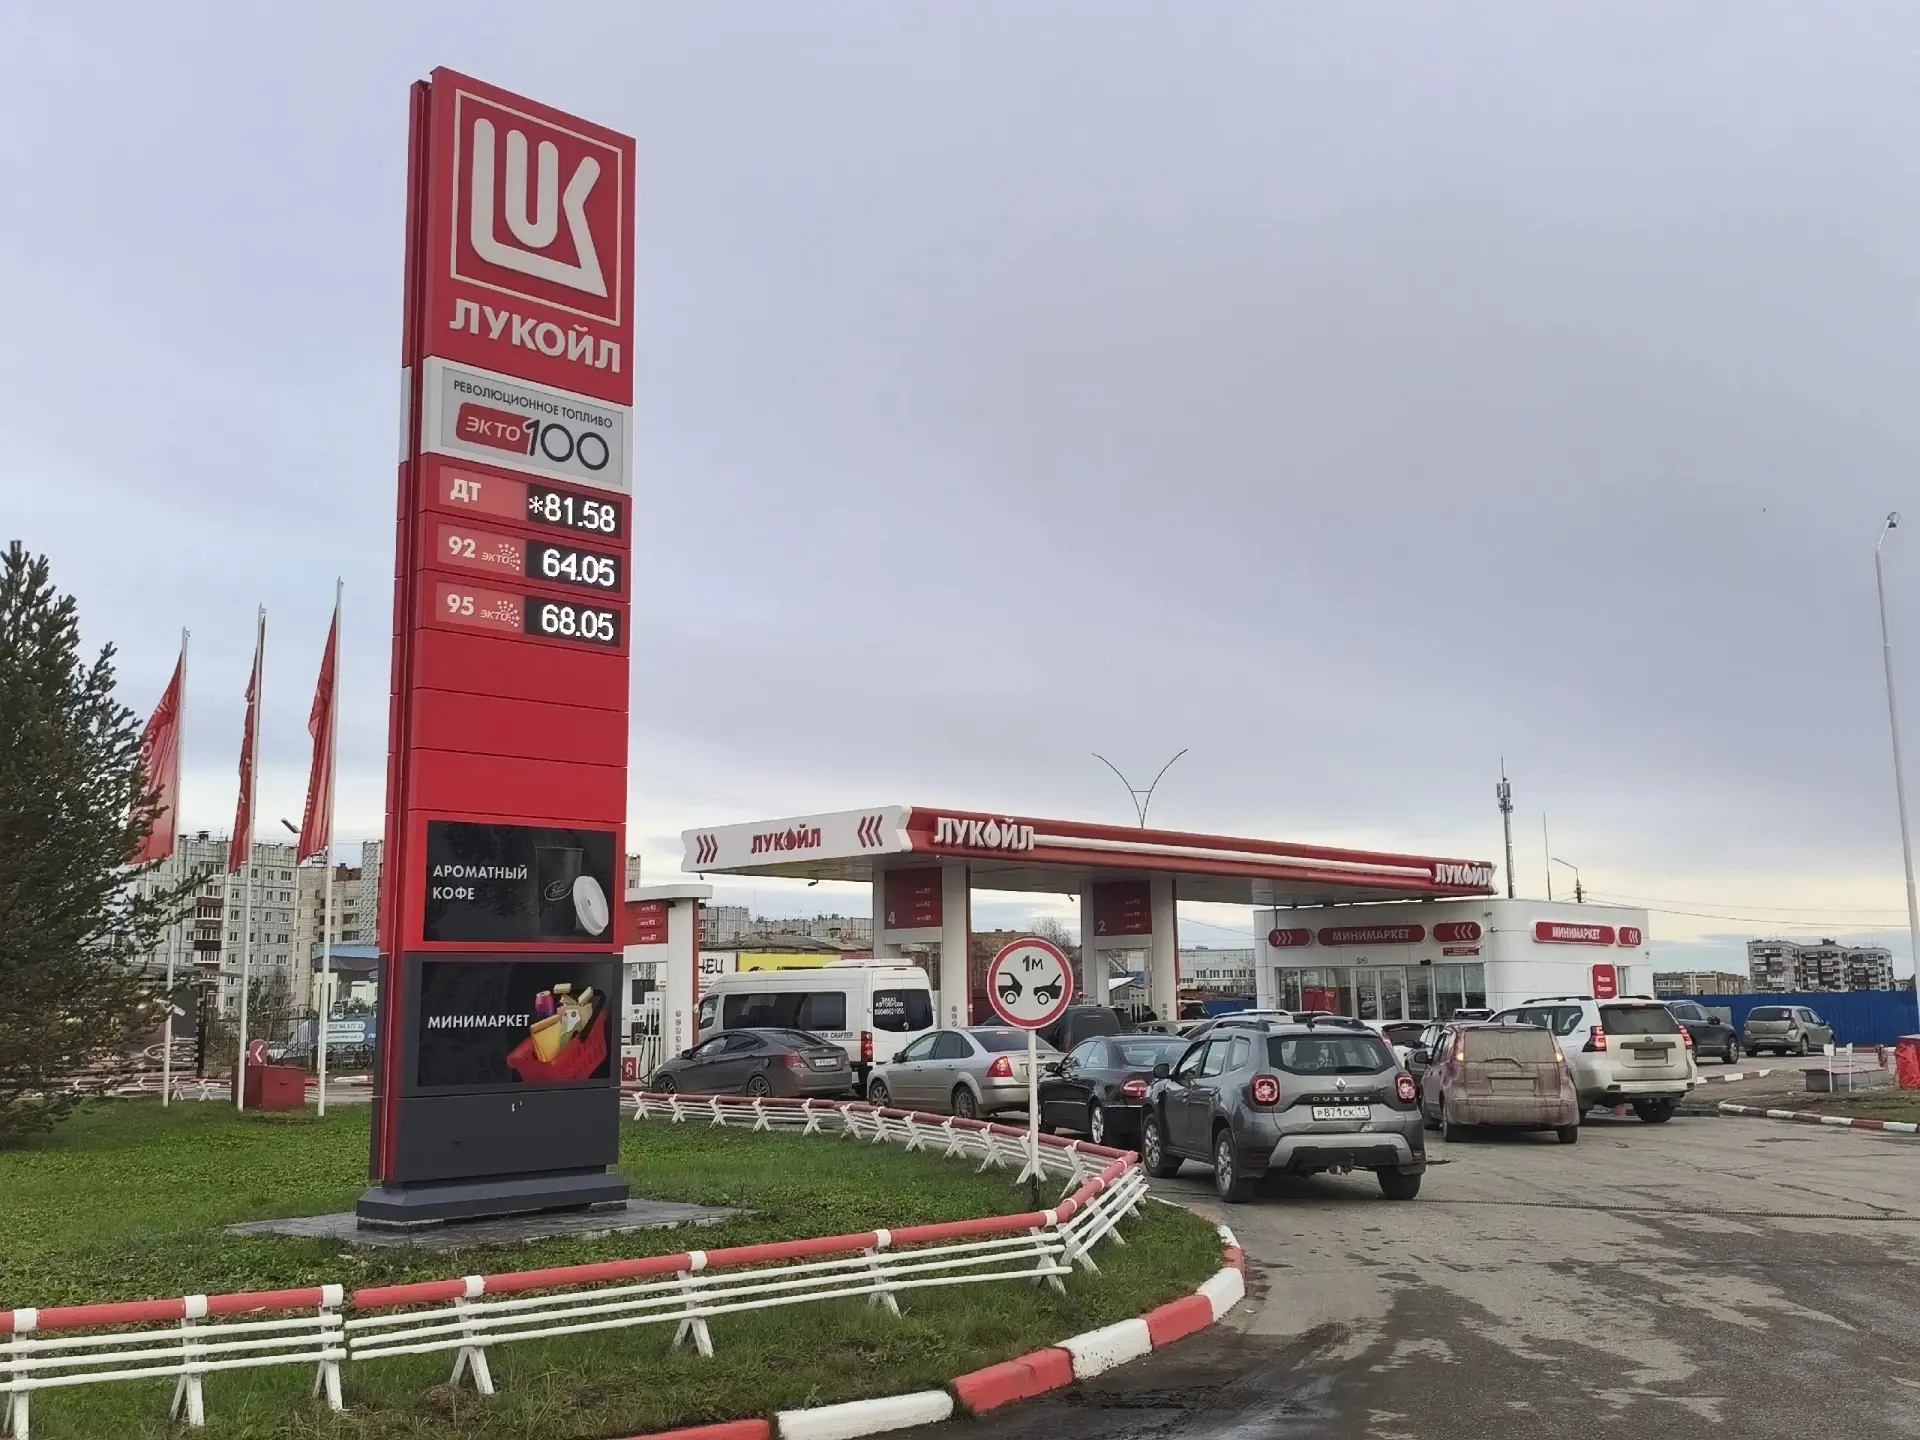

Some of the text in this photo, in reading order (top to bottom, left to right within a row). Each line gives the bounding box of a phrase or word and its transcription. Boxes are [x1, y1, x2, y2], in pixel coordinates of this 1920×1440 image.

[449, 298, 620, 373] ЛУКОЙЛ
[453, 379, 613, 429] РЕВОЛЮЦИОННОЕ ТОПЛИВО
[465, 416, 610, 471] ЭКТО 100
[450, 478, 482, 503] ДТ
[448, 535, 615, 587] 92 ЭКТО 64.05
[446, 593, 614, 641] 95 ЭКТО 68.05
[934, 816, 1035, 851] ЛУКОЙЛ
[433, 864, 528, 881] АРОМАТНЫЙ
[432, 886, 476, 901] КОФЕ
[888, 911, 896, 925] 4
[1099, 920, 1106, 932] 2
[1333, 929, 1410, 941] МИНИМАРКЕТ
[1552, 926, 1600, 940] МИНИМАРКЕТ
[428, 1014, 530, 1028] МИНИМАРКЕТ
[626, 1061, 633, 1077] 6
